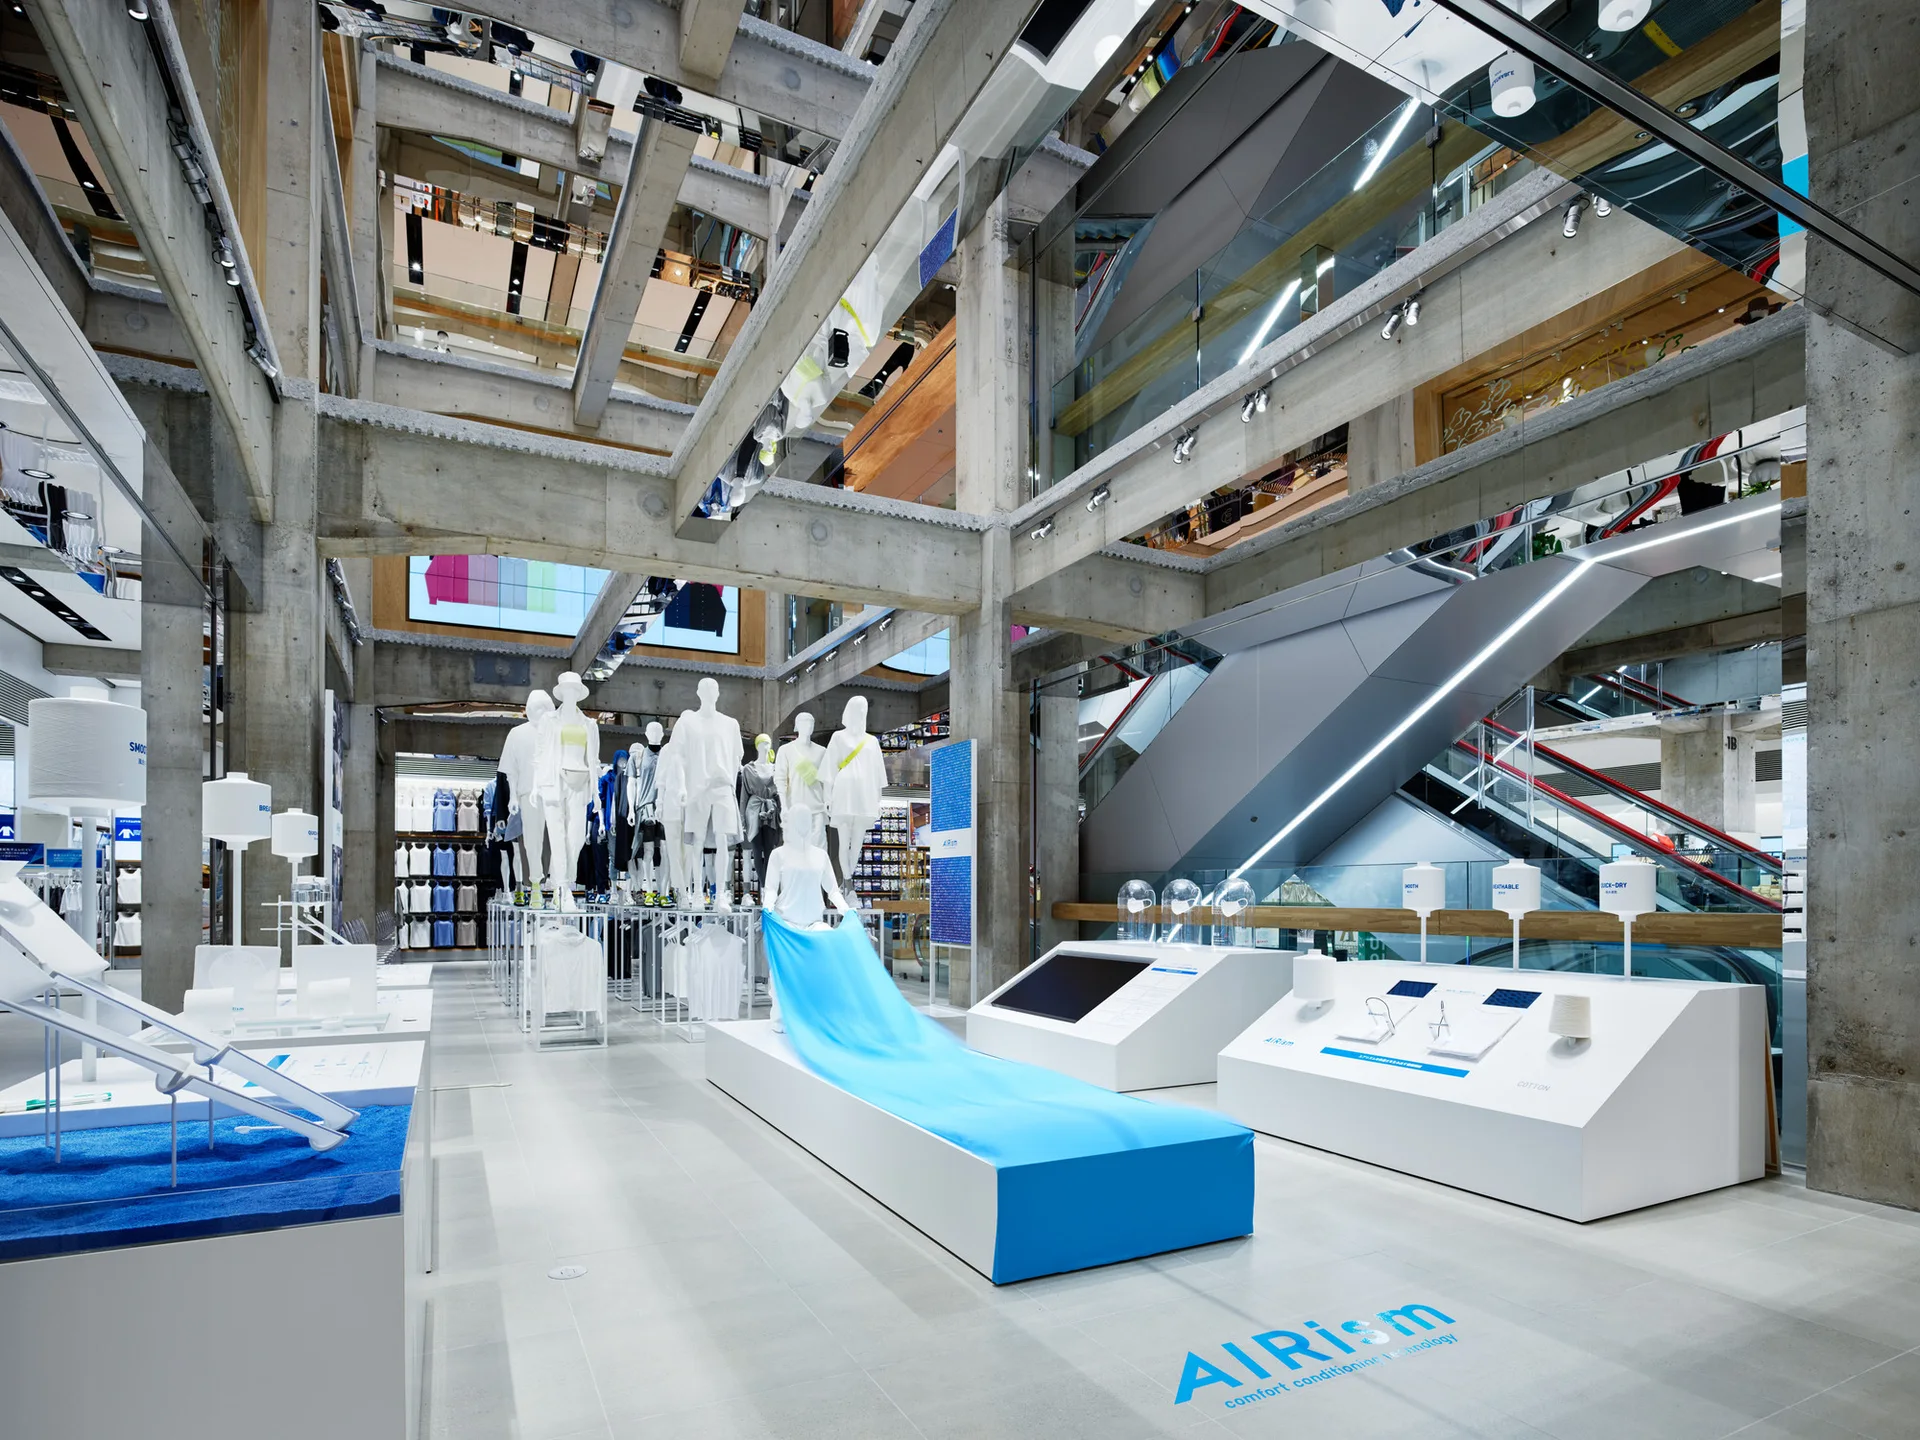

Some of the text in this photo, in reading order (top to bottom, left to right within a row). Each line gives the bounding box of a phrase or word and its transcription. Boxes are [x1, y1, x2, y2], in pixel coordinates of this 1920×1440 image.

[1517, 1080, 1551, 1092] COTTON
[1174, 1302, 1457, 1405] AIRism
[1224, 1332, 1459, 1409] comfort conditioning technology
